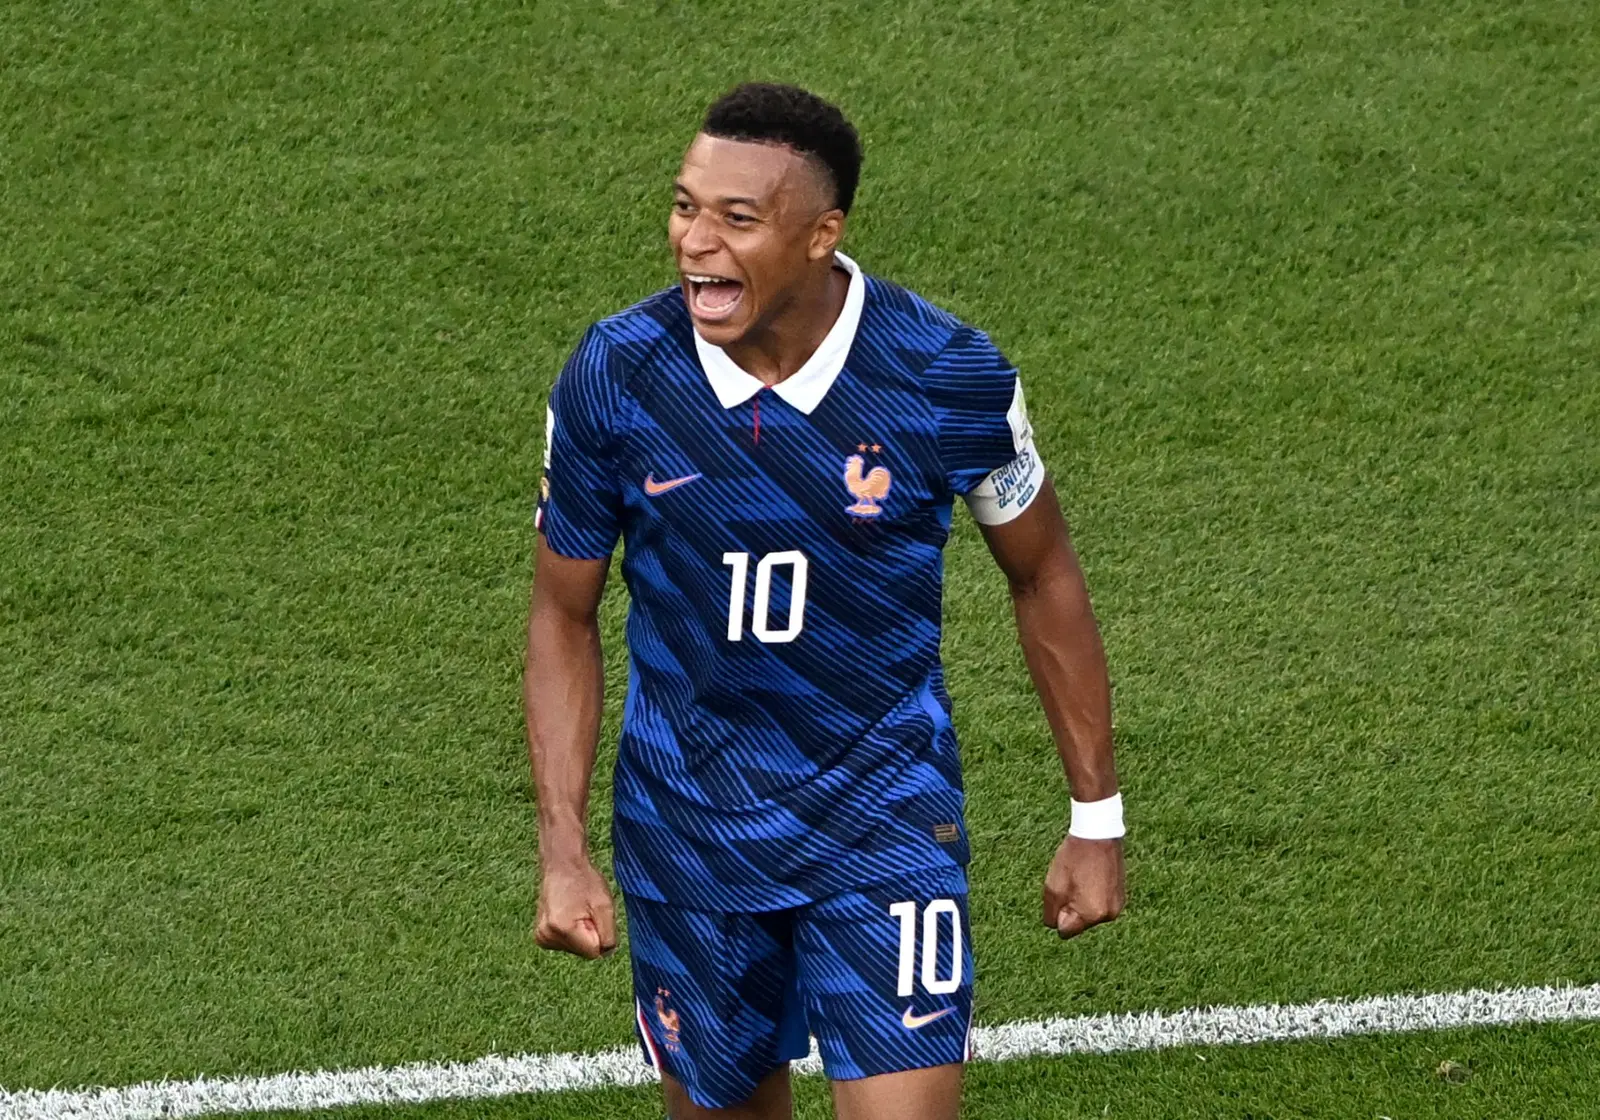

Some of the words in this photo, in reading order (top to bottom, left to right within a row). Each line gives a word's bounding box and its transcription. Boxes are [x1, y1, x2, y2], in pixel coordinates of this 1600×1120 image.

[995, 452, 1030, 496] UNITES
[997, 493, 1016, 509] the
[722, 551, 808, 643] 10
[890, 899, 963, 997] 10
